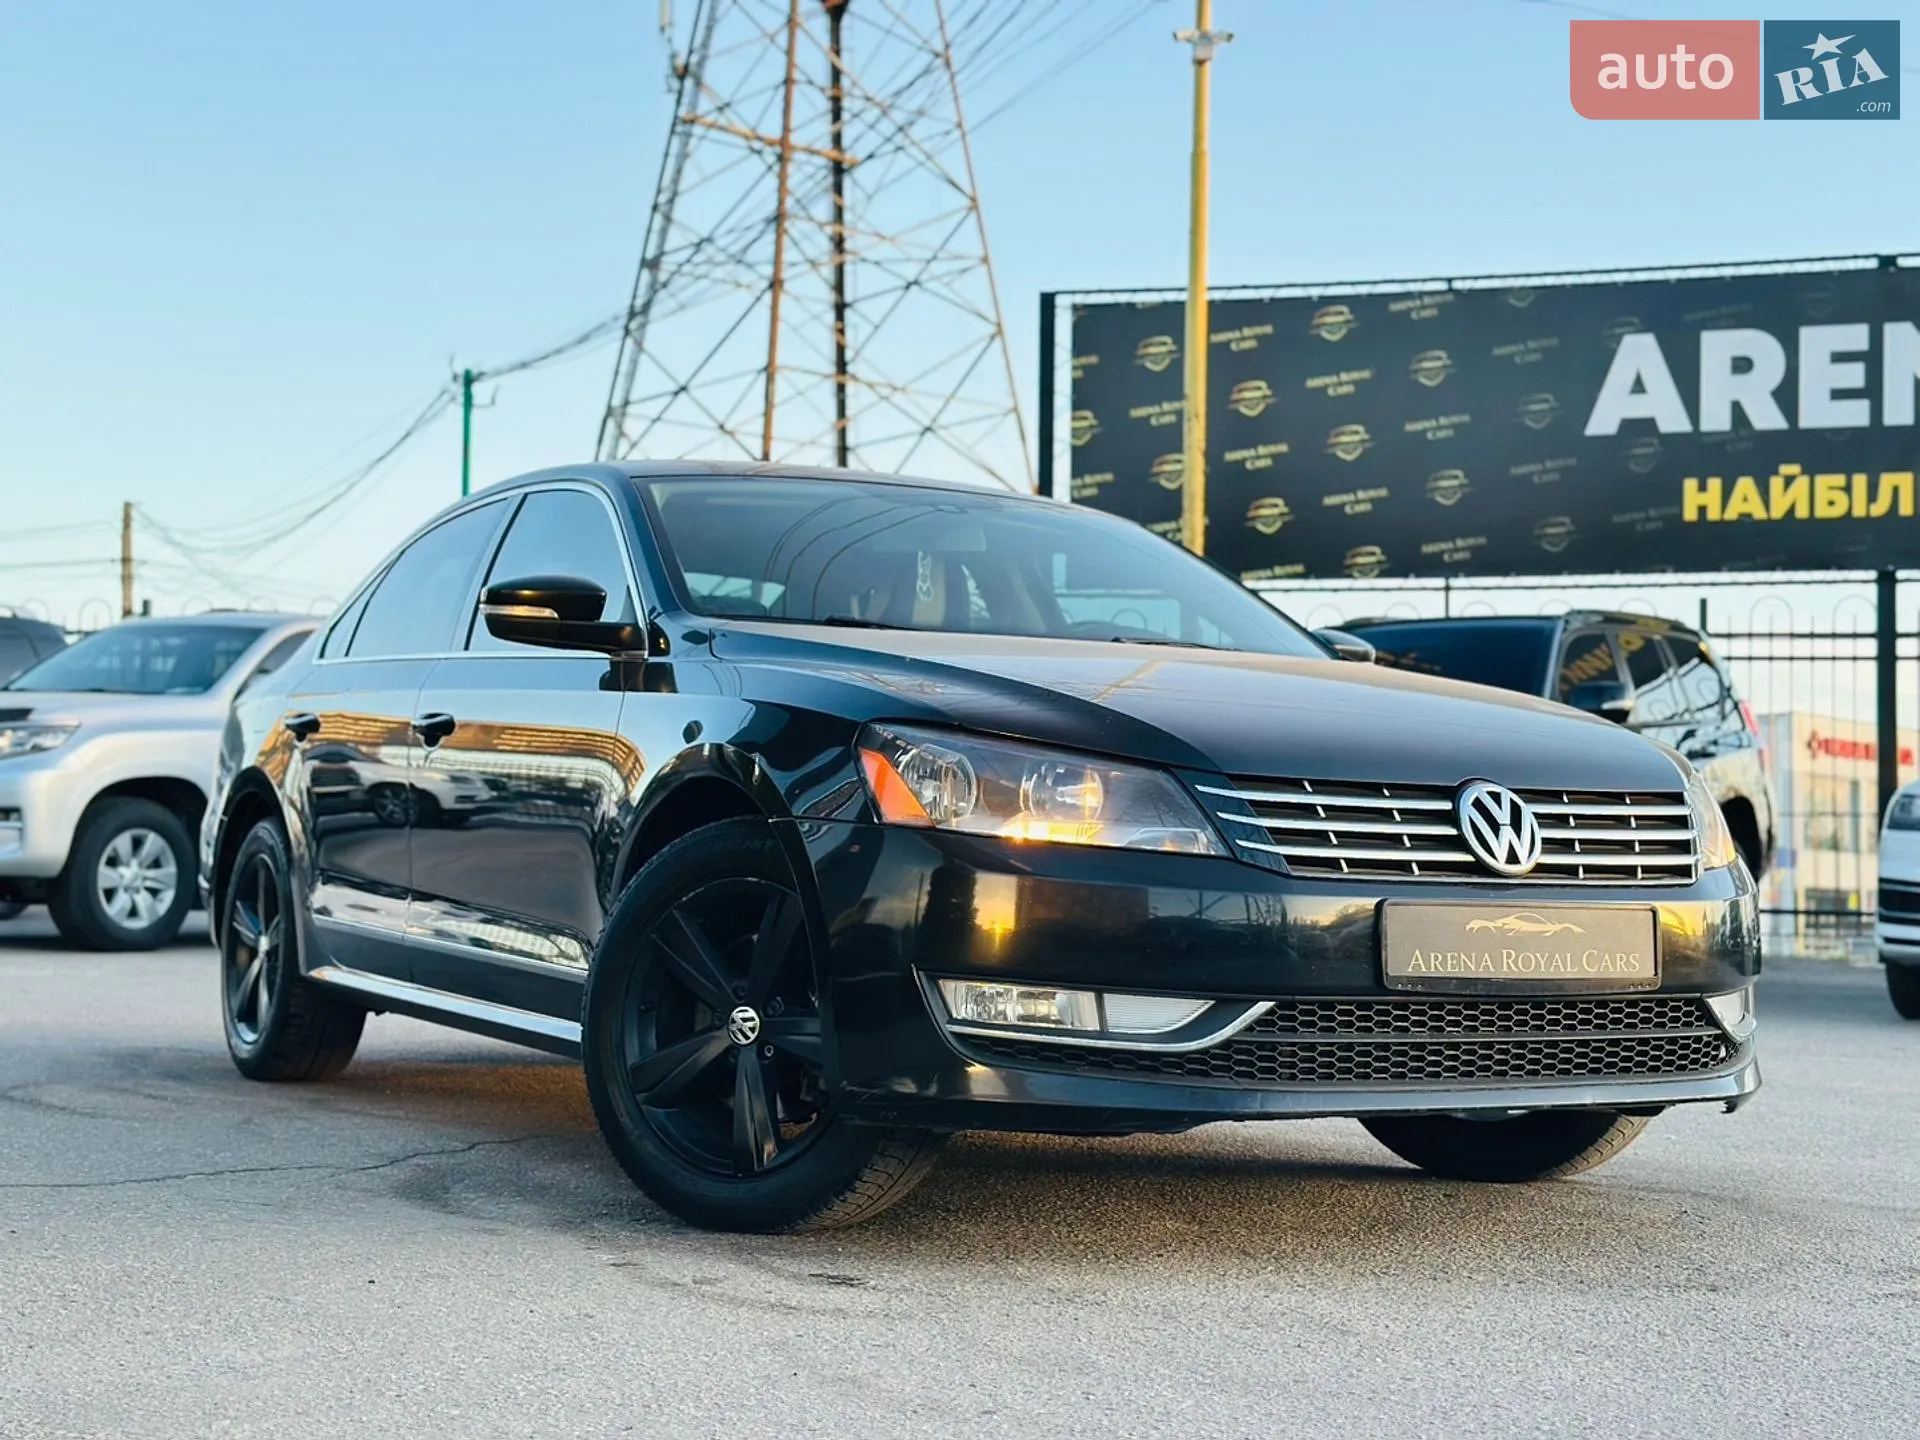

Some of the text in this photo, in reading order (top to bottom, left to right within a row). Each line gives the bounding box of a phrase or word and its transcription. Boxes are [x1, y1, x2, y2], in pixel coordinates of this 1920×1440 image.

[1682, 464, 1915, 522] НАЙБІЛ
[1407, 948, 1640, 973] ARENA ROYAL CARS
